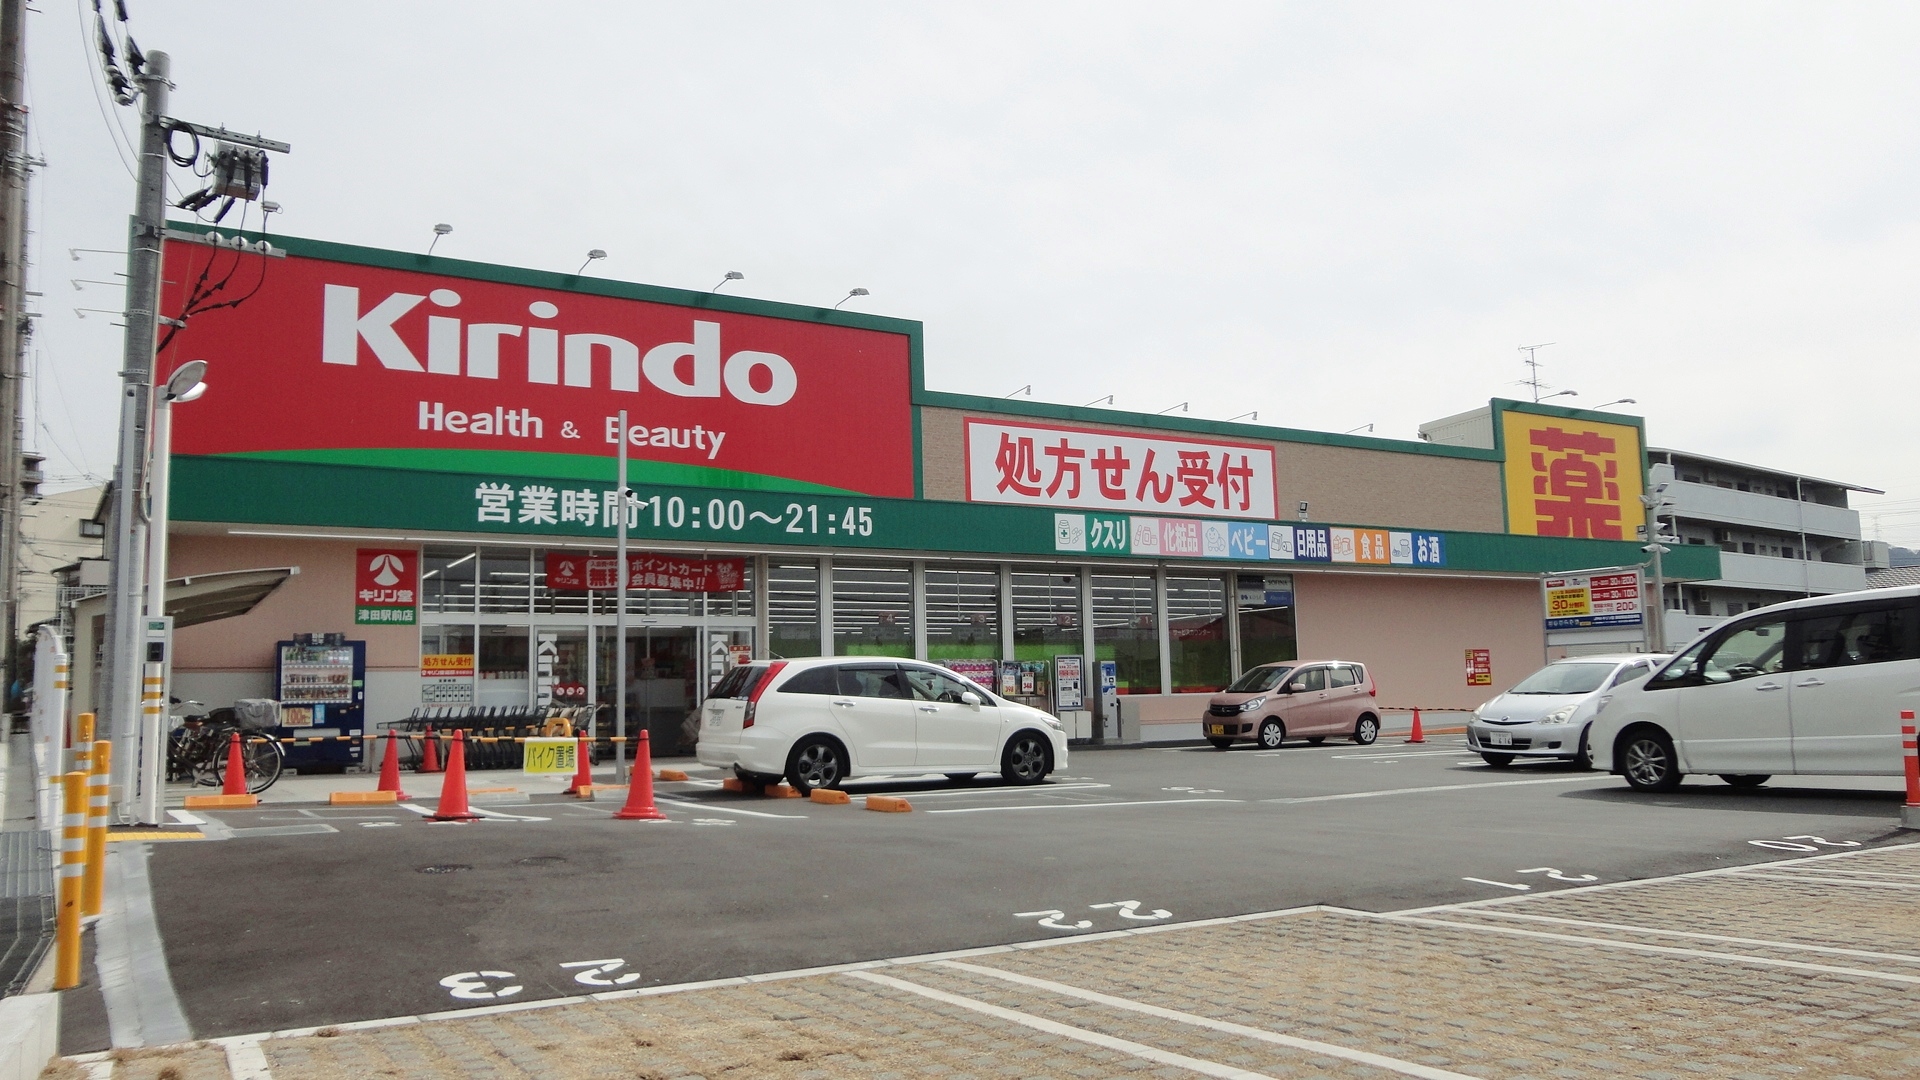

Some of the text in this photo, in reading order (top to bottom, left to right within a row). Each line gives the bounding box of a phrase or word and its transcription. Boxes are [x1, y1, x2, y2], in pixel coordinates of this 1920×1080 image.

[321, 283, 798, 407] Kirindo
[417, 400, 726, 460] Health & Beauty
[994, 431, 1255, 512] 処方せん受付
[1529, 426, 1624, 540] 薬
[1090, 518, 1440, 564] クスリ 化粧品 ベビー 日用品 食品 お酒
[631, 558, 714, 575] ポイントカード
[359, 589, 414, 603] キリン堂
[358, 609, 414, 622] 津田駅前店
[423, 656, 472, 667] 処方せん受付
[1461, 866, 1599, 891] 21
[1013, 899, 1173, 931] 22
[439, 957, 642, 1000] 23
